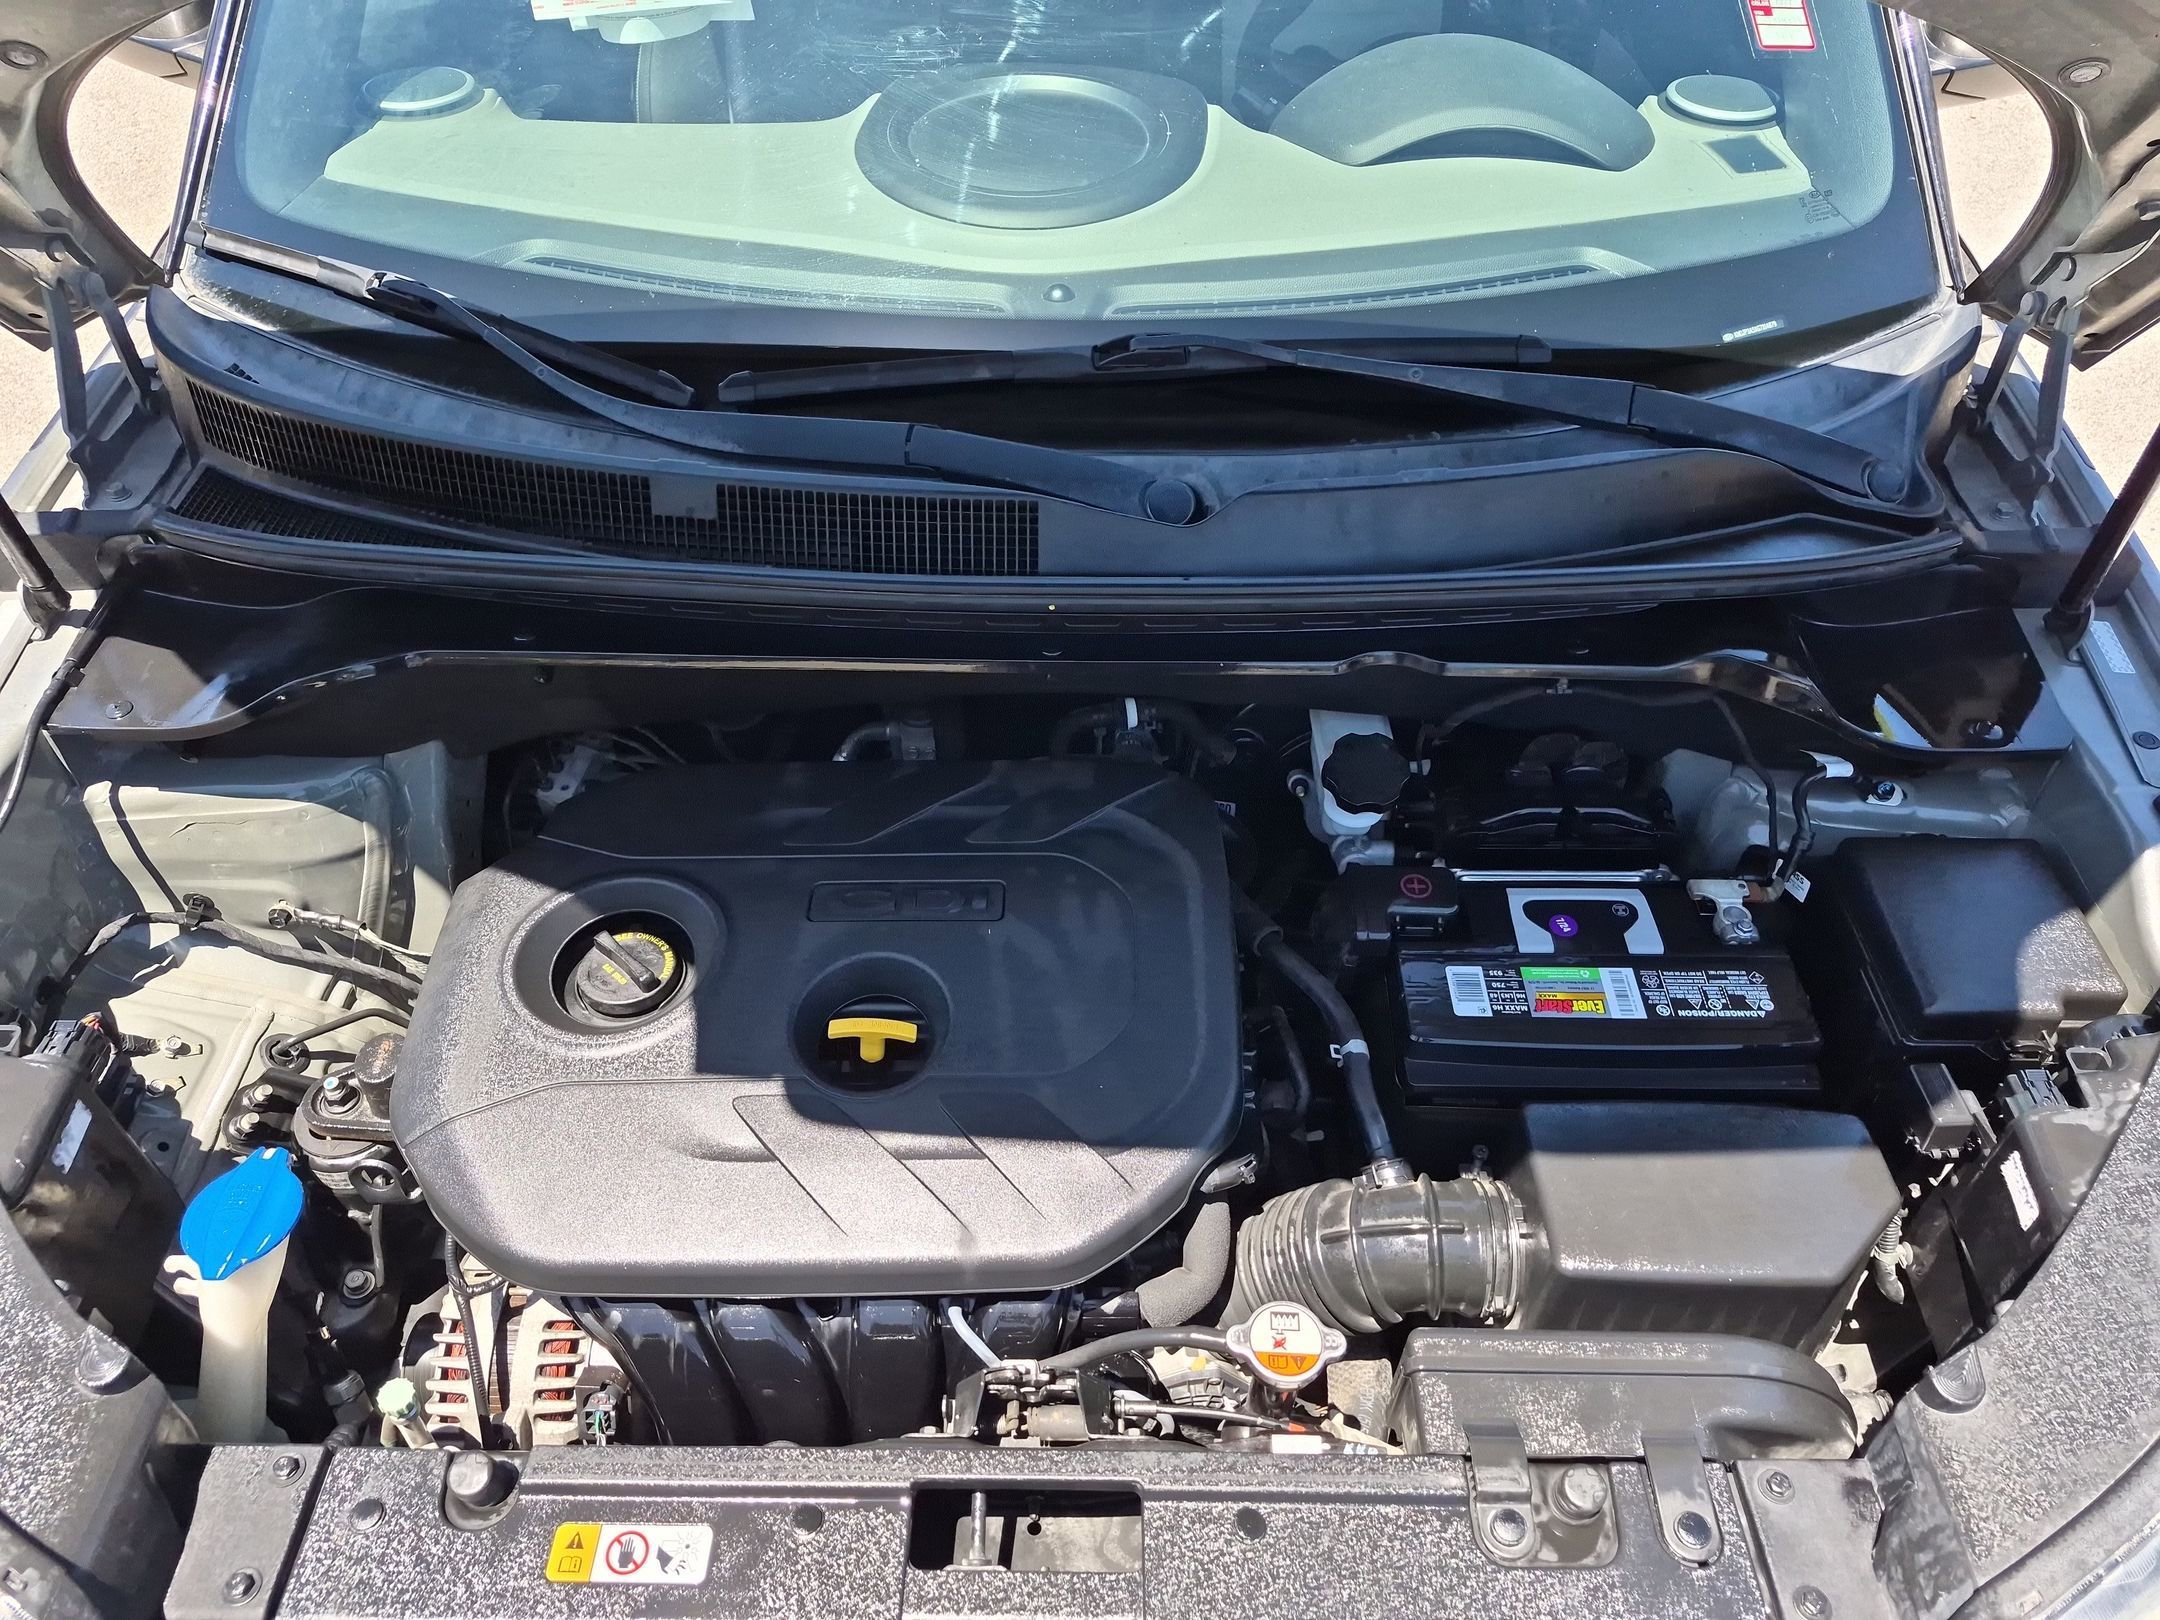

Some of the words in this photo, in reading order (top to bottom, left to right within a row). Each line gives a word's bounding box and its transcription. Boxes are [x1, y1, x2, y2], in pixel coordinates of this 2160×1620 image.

[636, 932, 669, 951] OWNER'S
[1504, 1004, 1528, 1012] MAXX
[1535, 999, 1606, 1014] EverStart
[1677, 1009, 1758, 1017] DANGER/POISON
